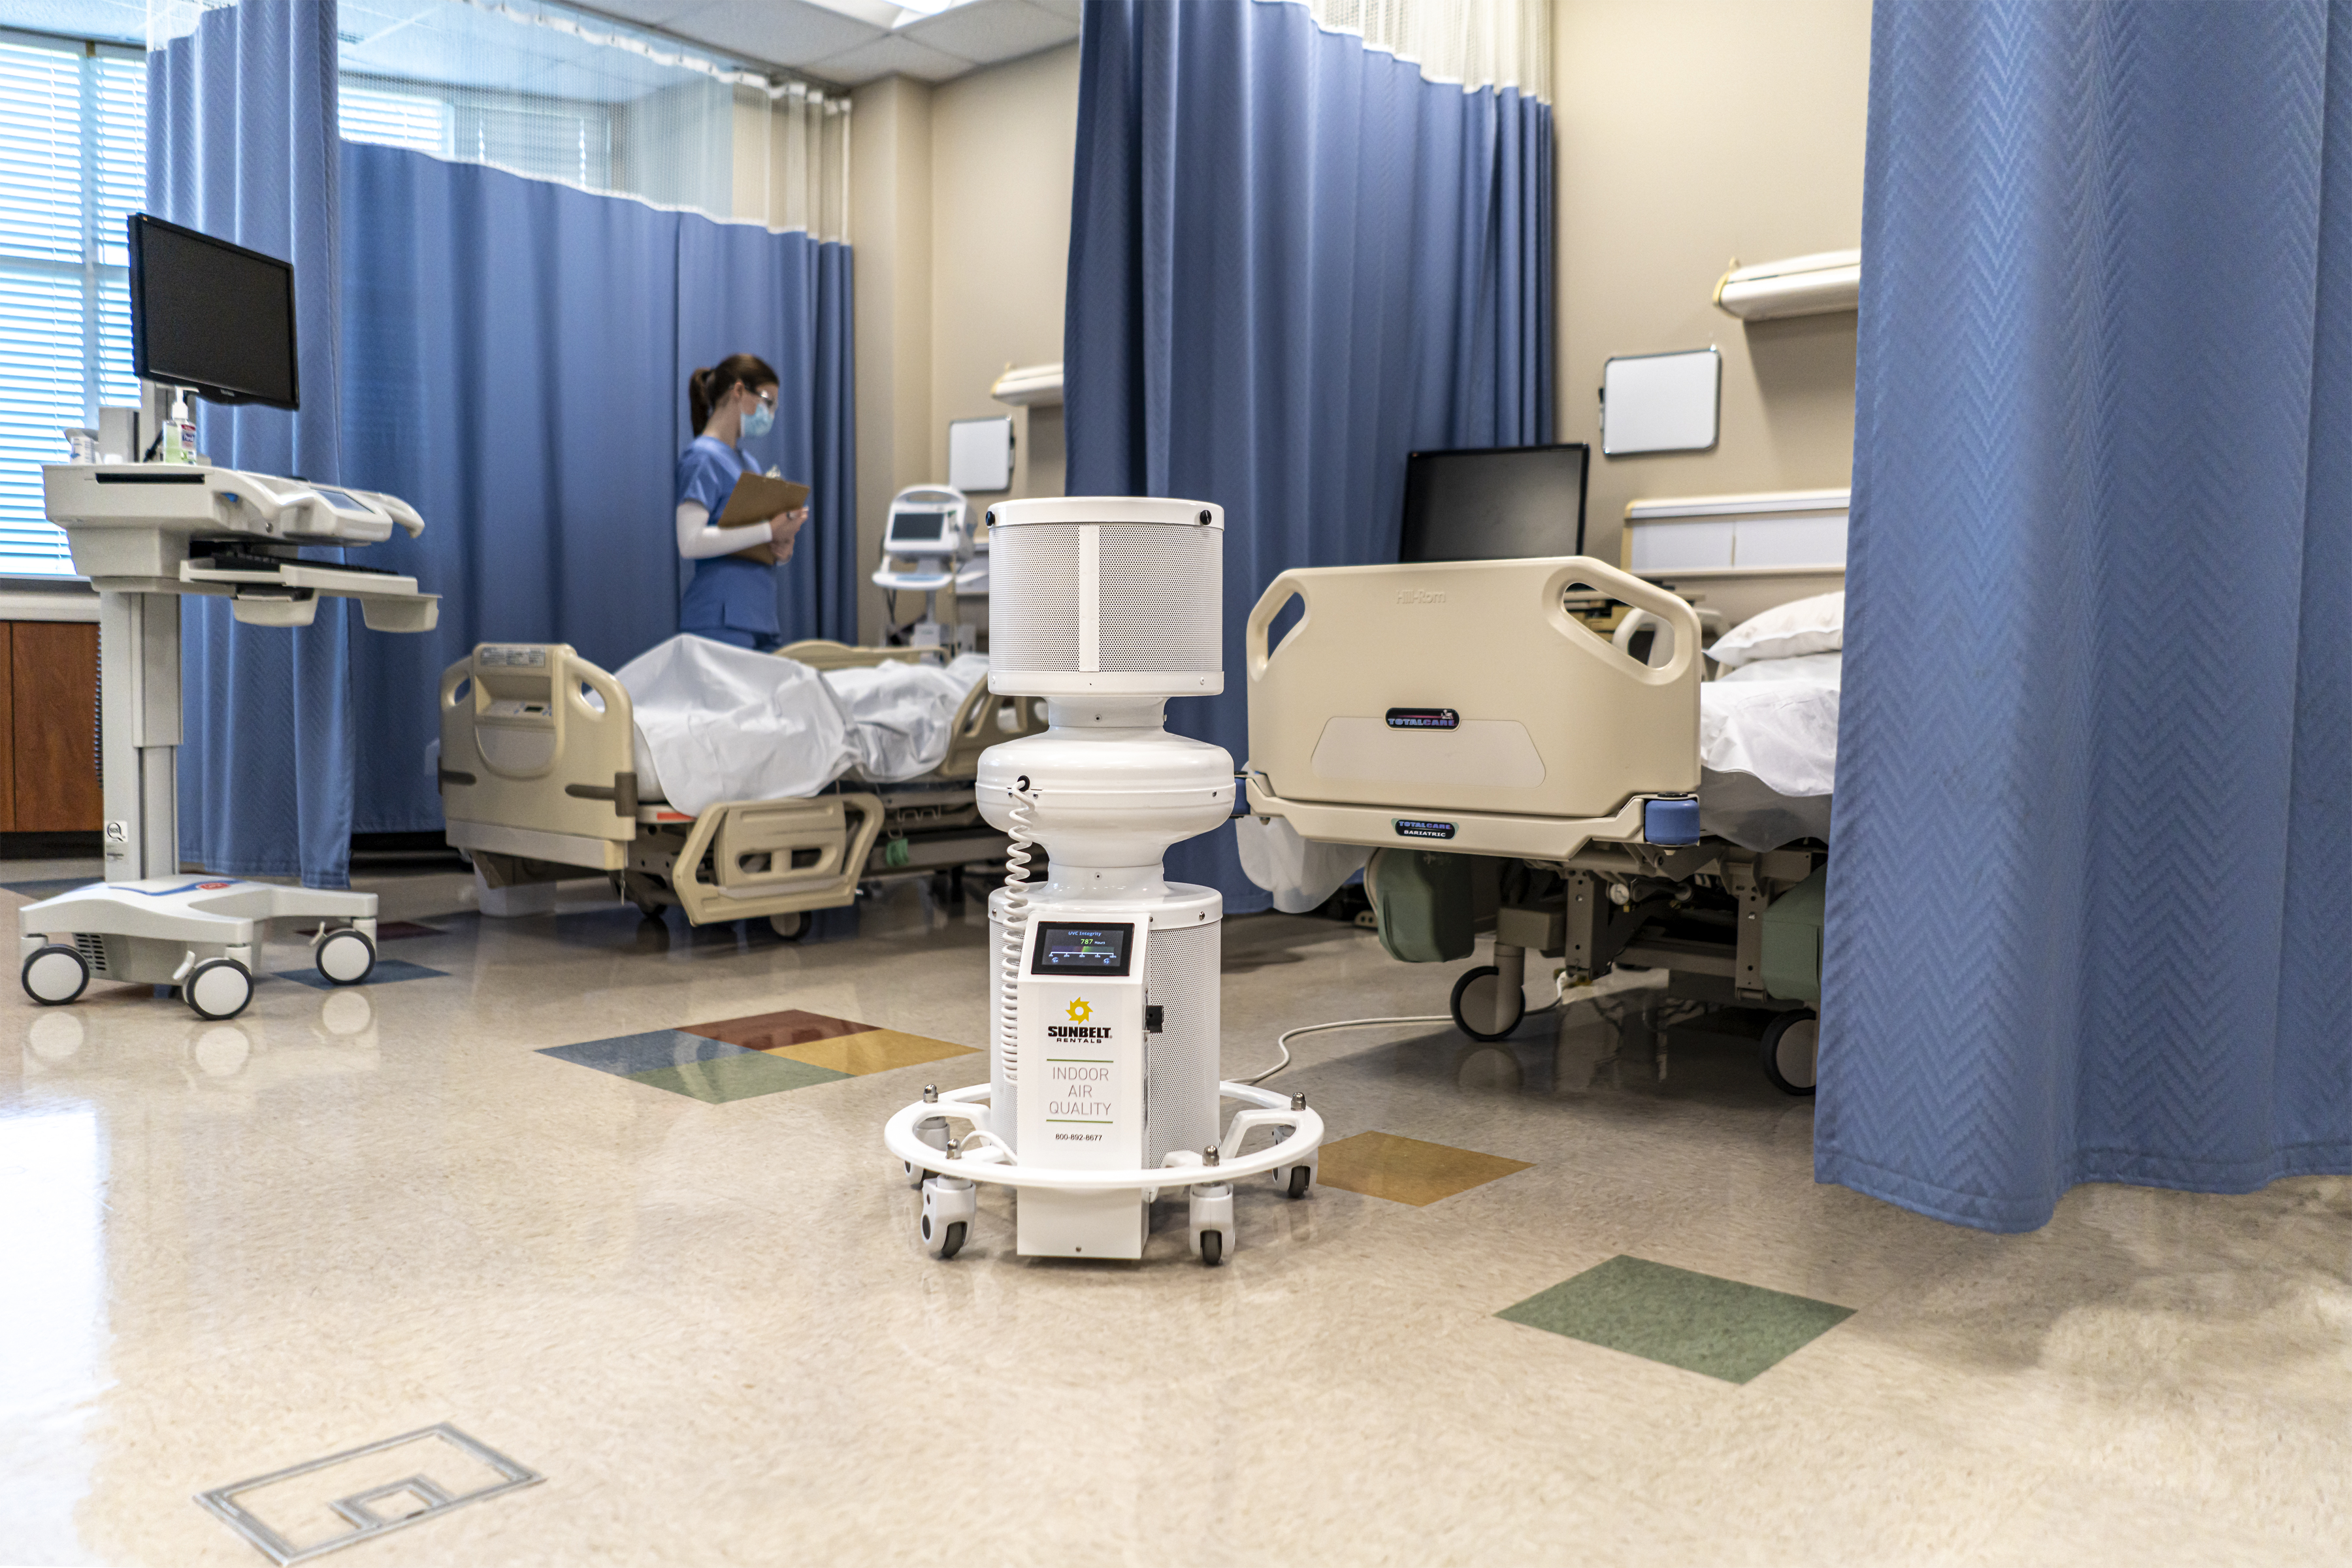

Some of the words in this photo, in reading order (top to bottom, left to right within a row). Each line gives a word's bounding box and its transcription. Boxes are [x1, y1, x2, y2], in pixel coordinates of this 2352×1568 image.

[1396, 589, 1446, 604] Hill-Rom
[1047, 1026, 1111, 1038] SUNBELT
[1053, 1066, 1109, 1081] INDOOR
[1068, 1084, 1092, 1098] AIR
[1049, 1101, 1111, 1115] QUALITY
[1055, 1133, 1103, 1141] 800-892-8677
